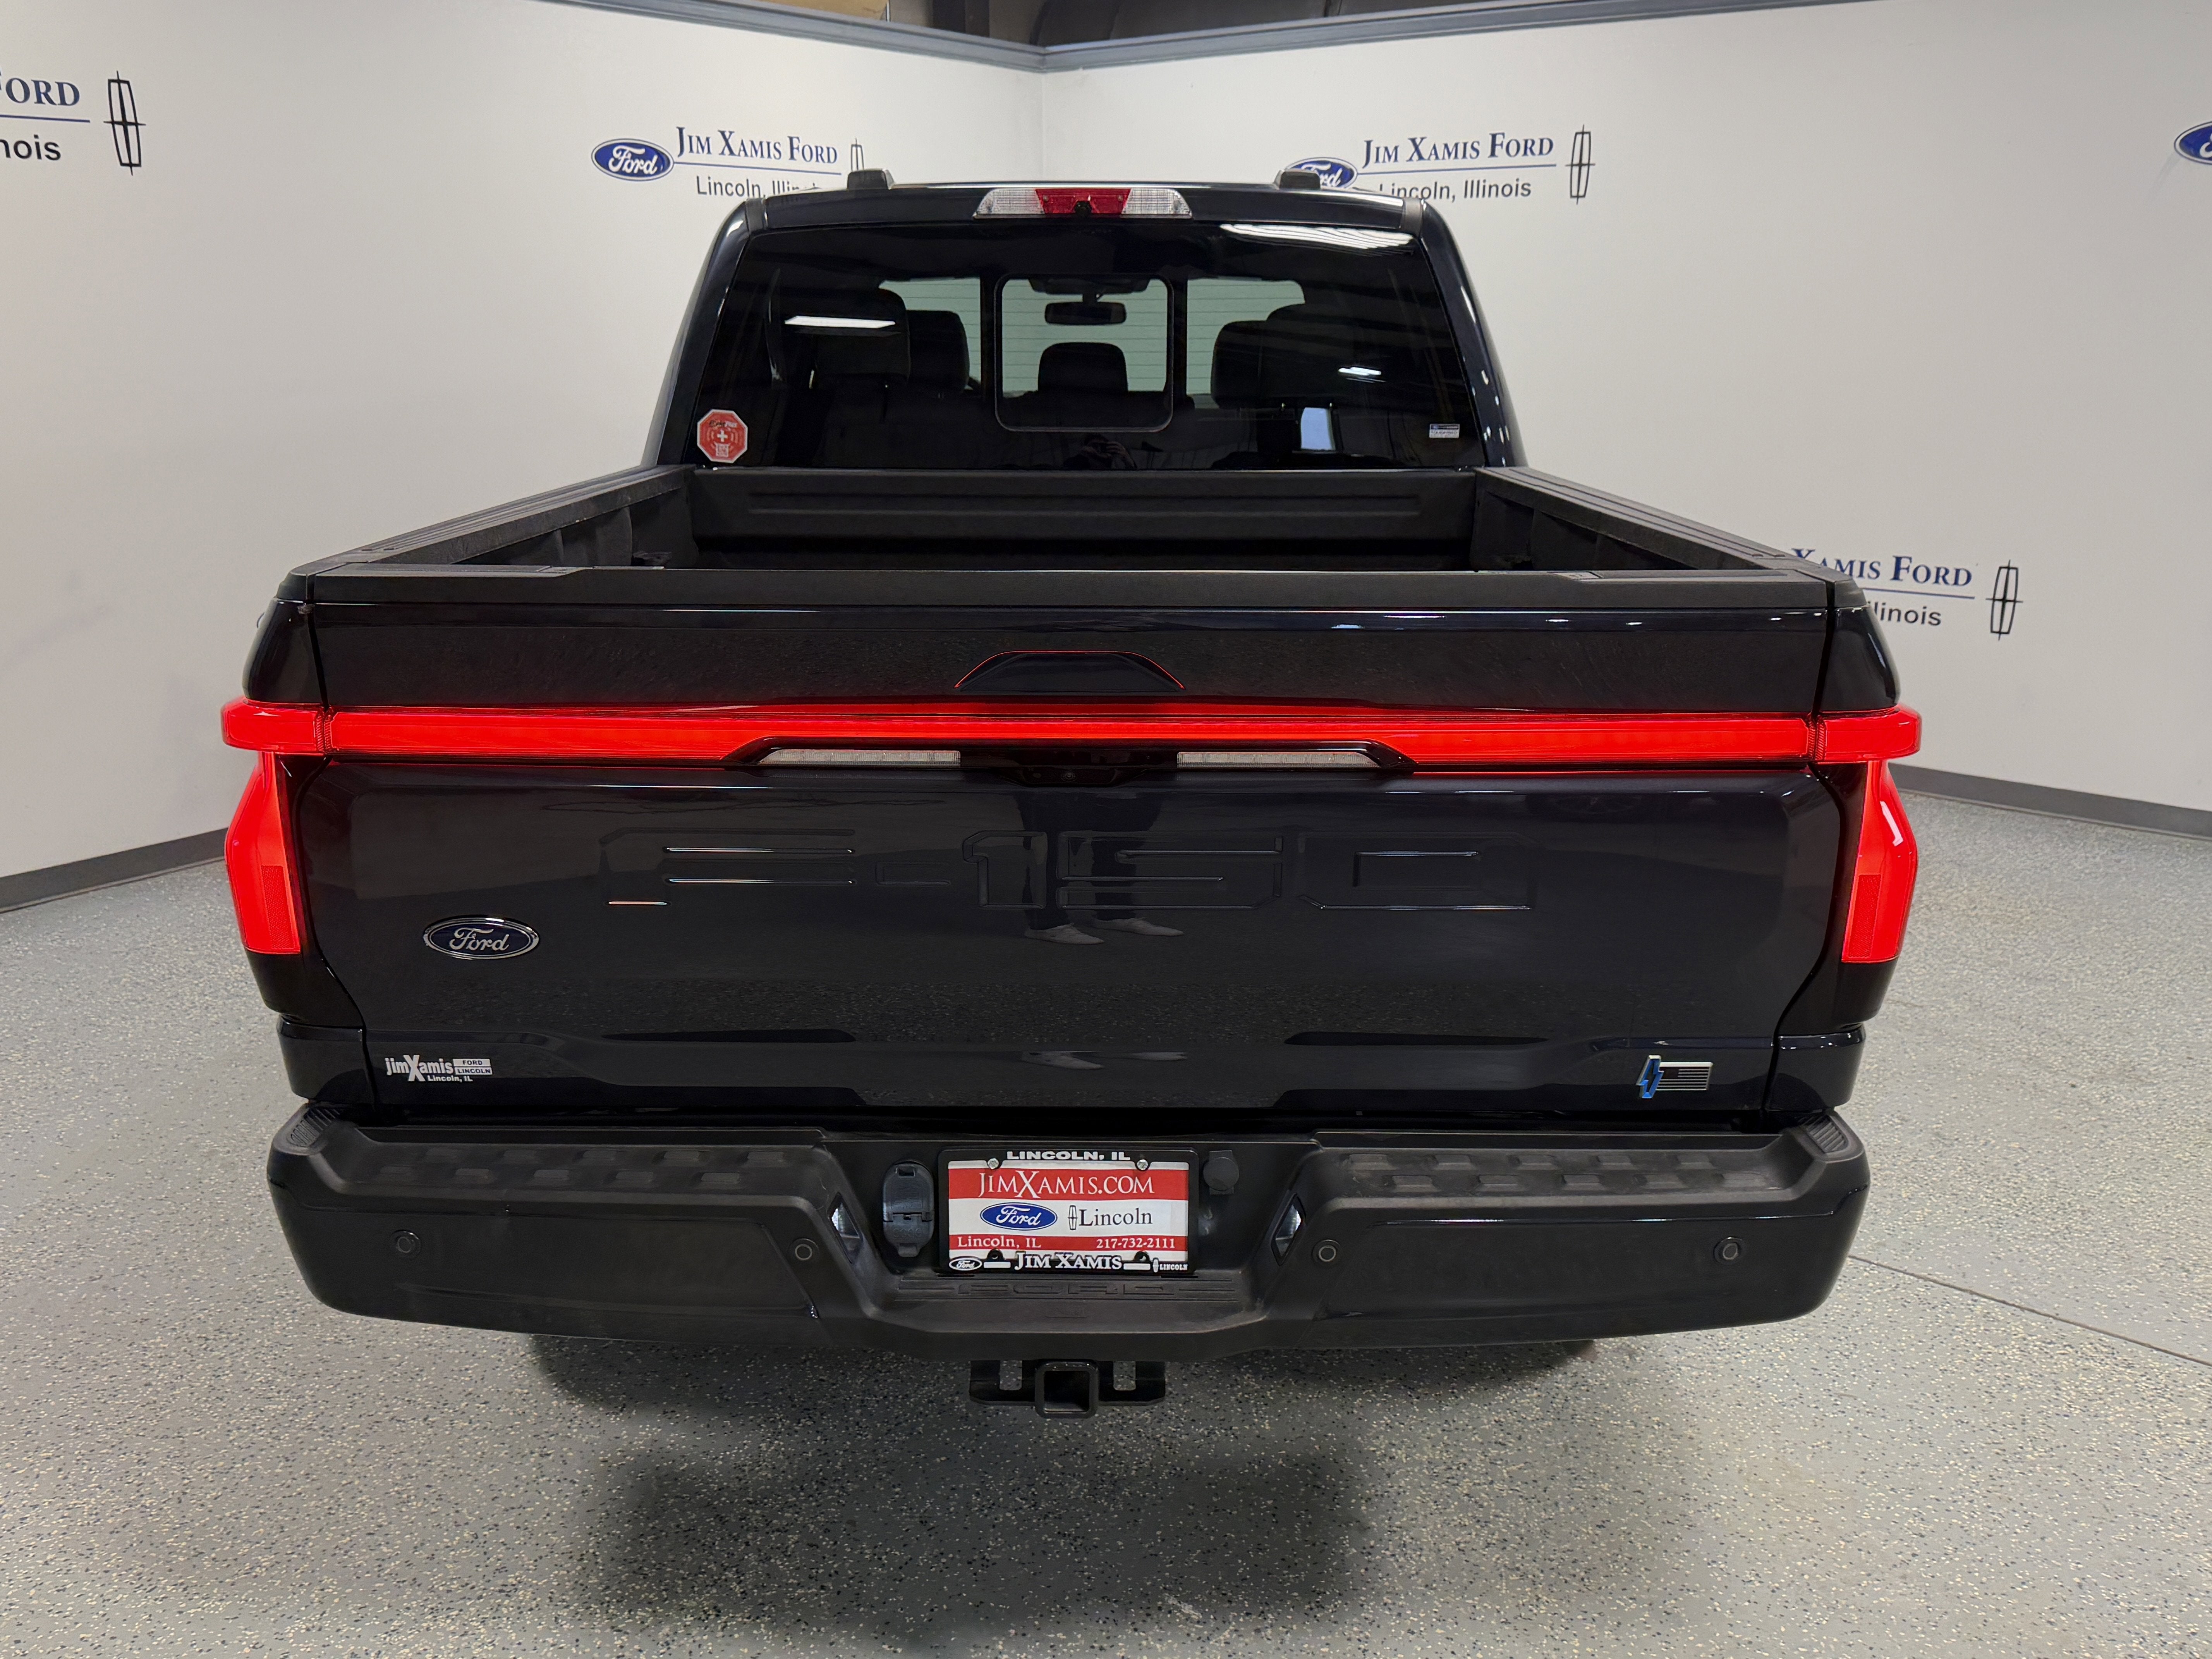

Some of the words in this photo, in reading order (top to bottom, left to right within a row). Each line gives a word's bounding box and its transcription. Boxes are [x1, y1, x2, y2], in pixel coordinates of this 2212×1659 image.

[0, 70, 80, 106] ORD
[675, 126, 711, 158] JIM
[718, 129, 781, 160] XAMIS
[788, 136, 838, 164] FORD
[1362, 139, 1400, 169] JIM
[1407, 136, 1480, 161] XAMIS
[1488, 132, 1554, 158] FORD
[608, 145, 658, 174] Ford
[1380, 181, 1455, 203] incoln,
[1464, 178, 1531, 200] Illinois
[1890, 555, 1972, 586] FORD
[449, 927, 510, 951] Ford
[1007, 1151, 1104, 1160] LINCOLN,
[1111, 1152, 1131, 1161] IL
[978, 1170, 1155, 1199] JIMXAMIS.COM
[996, 1206, 1042, 1226] Ford
[1079, 1208, 1153, 1226] Lincoln
[958, 1236, 1020, 1248] Lincoln,
[1026, 1237, 1041, 1248] IL
[1096, 1238, 1175, 1249] 217-732-2111
[957, 1260, 975, 1268] Ford
[1014, 1252, 1052, 1271] JIM
[1056, 1252, 1122, 1269] XAMIS
